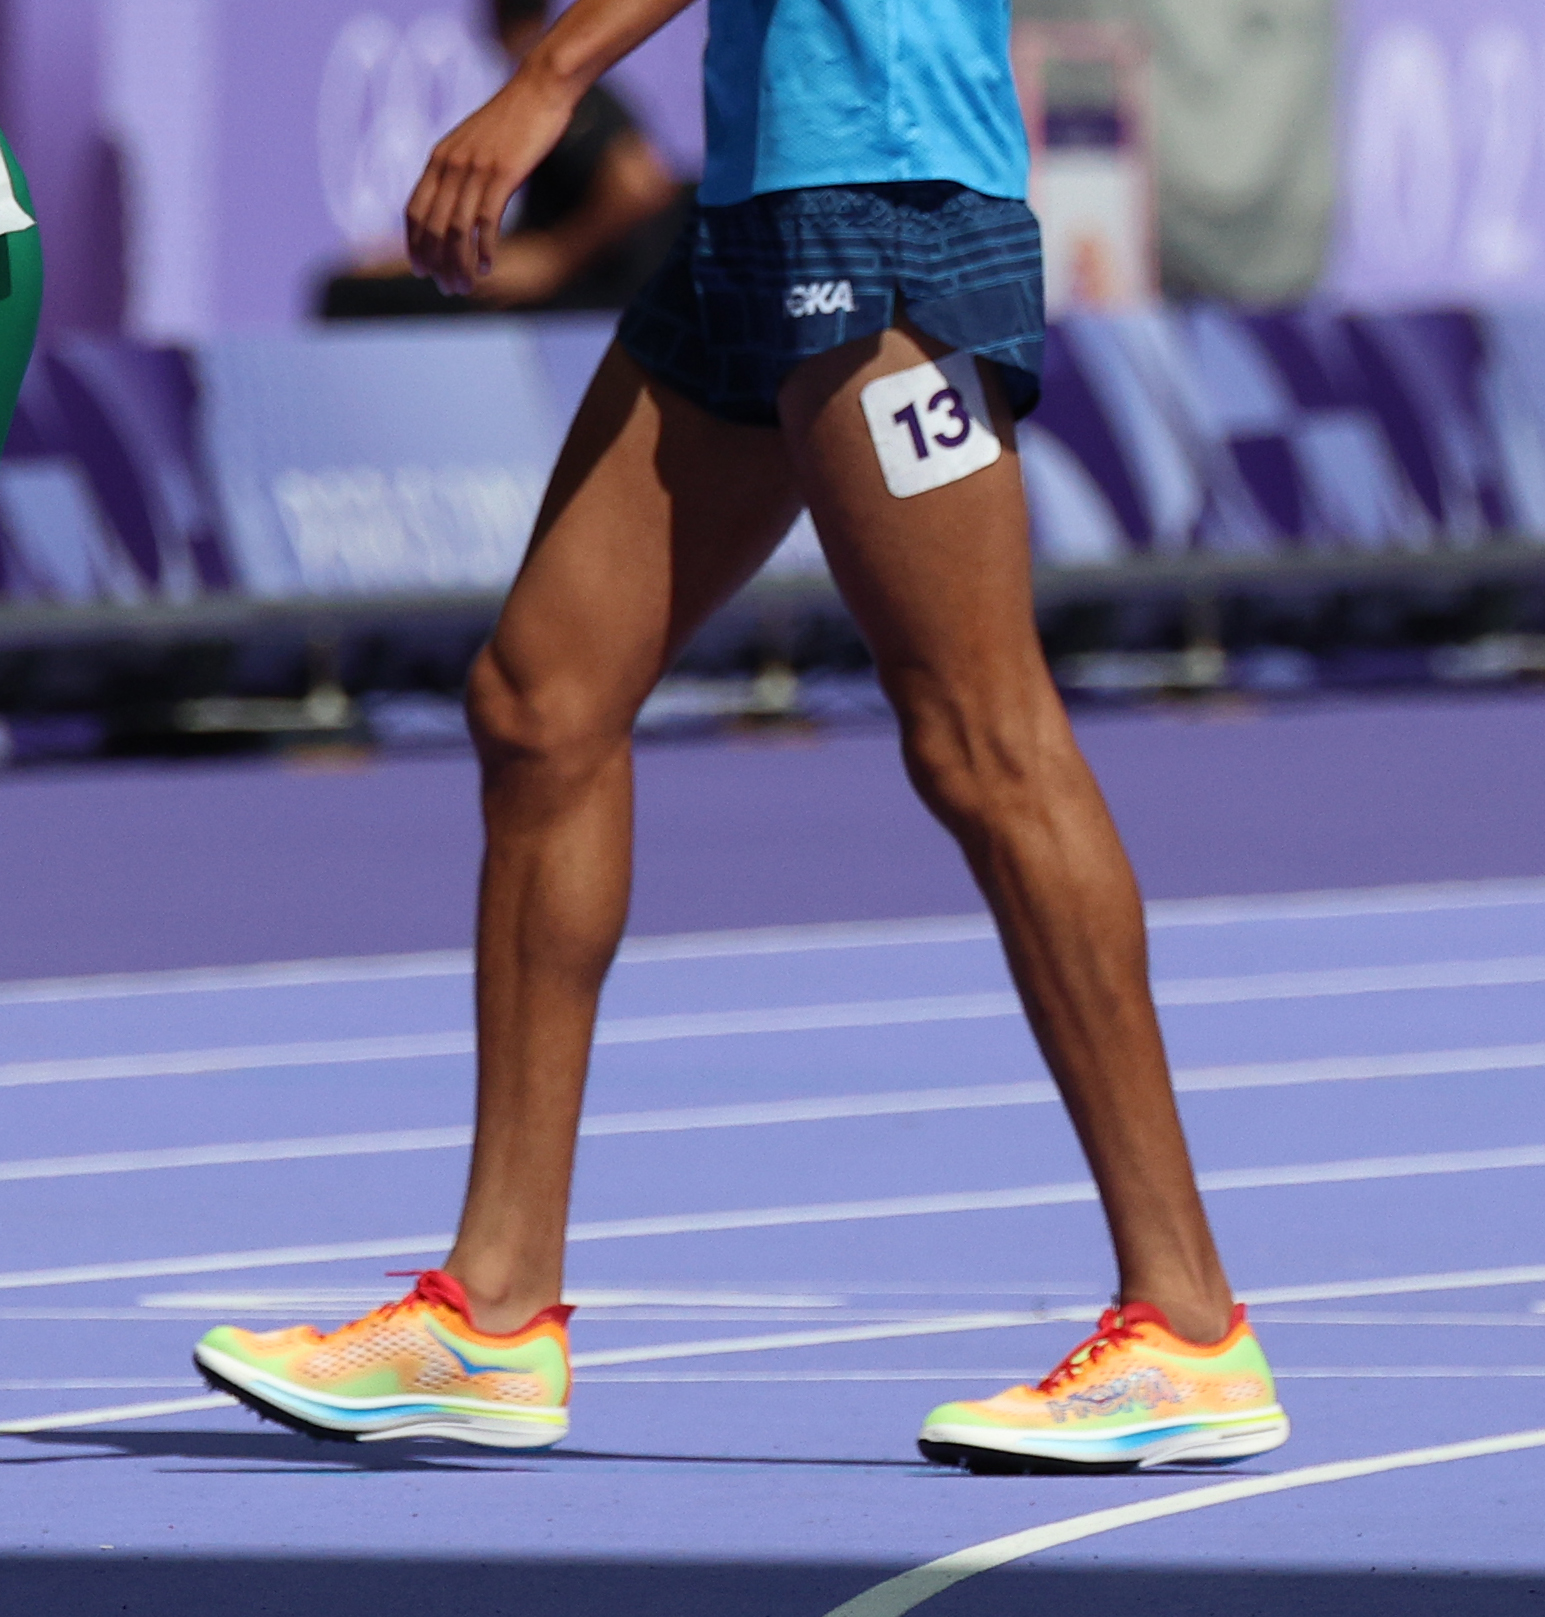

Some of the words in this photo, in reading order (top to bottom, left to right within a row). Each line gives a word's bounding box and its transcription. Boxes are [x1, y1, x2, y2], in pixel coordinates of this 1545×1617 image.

[785, 279, 858, 318] OKA
[893, 387, 971, 459] 13
[1045, 1367, 1182, 1423] HOKA
